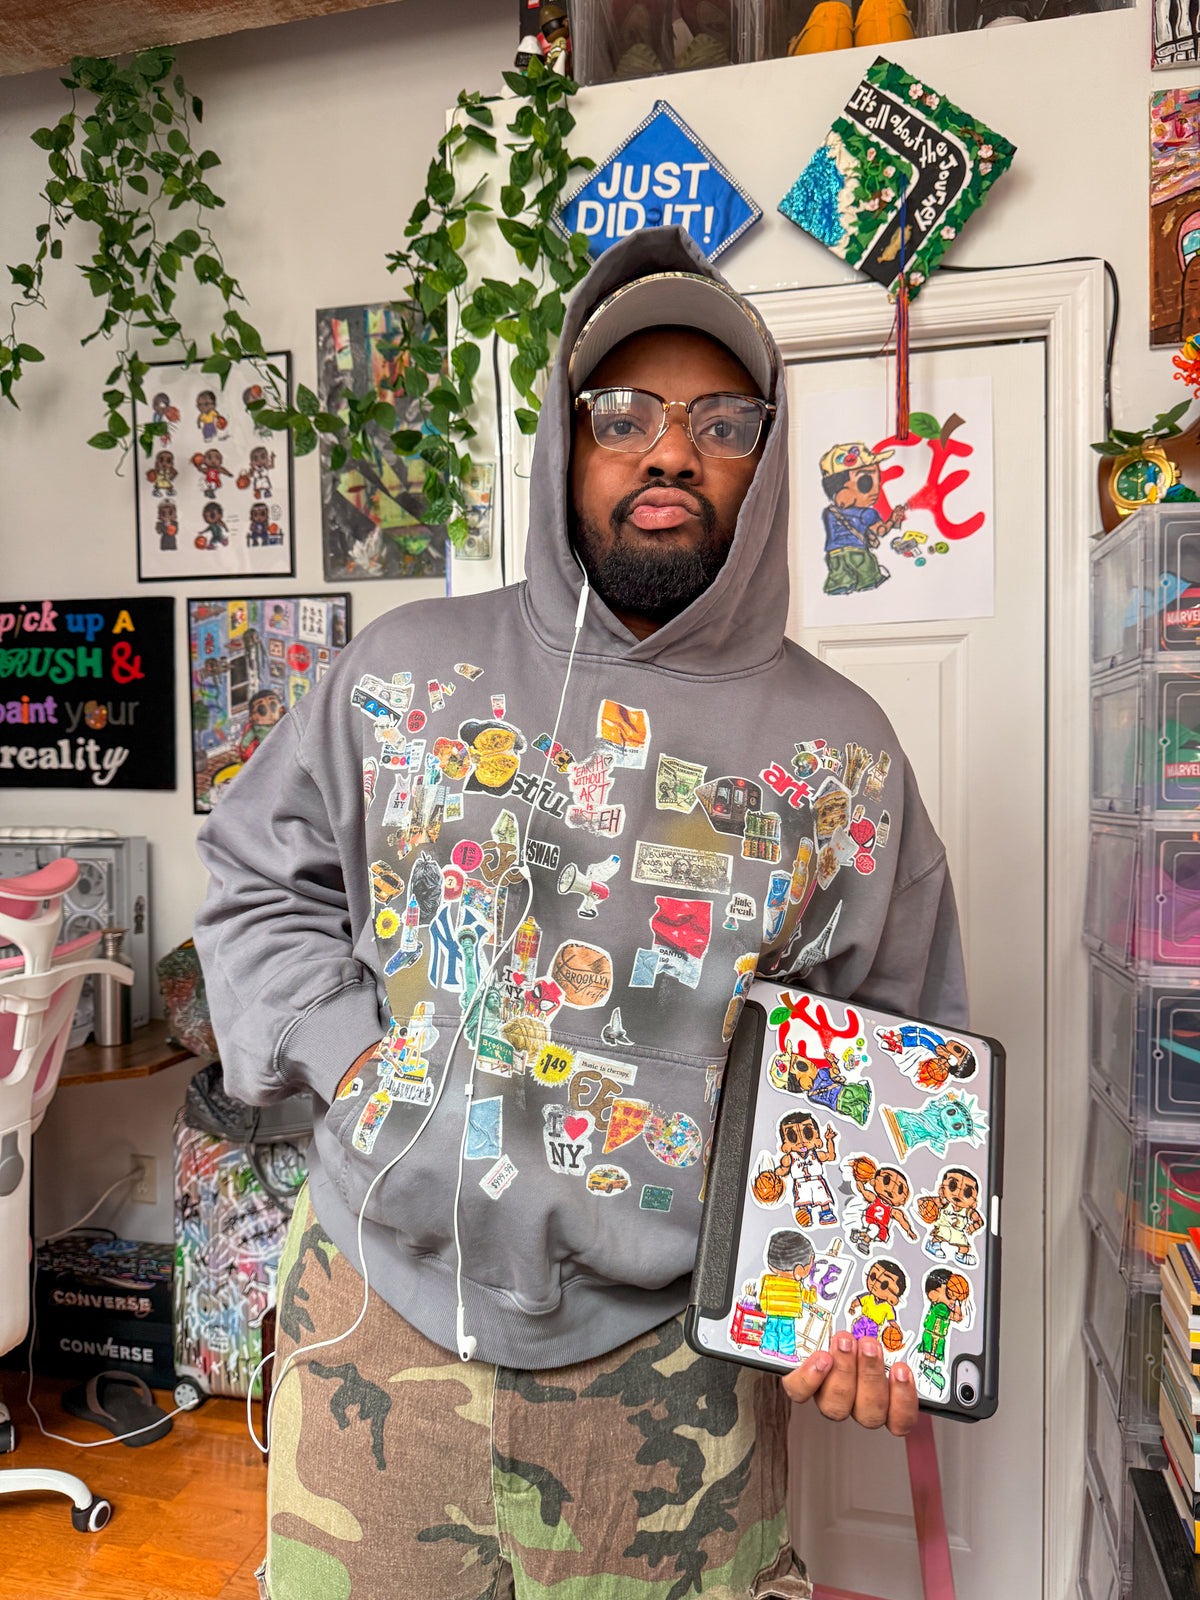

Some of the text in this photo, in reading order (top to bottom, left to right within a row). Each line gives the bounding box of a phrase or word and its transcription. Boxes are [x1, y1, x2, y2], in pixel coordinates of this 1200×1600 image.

[848, 85, 877, 113] It's
[865, 104, 891, 129] all
[890, 115, 926, 151] about
[919, 138, 947, 168] the
[598, 162, 710, 200] JUST
[576, 201, 714, 244] DID IT!
[0, 600, 135, 642] pick up A
[1166, 609, 1200, 624] MARVE
[112, 641, 145, 684] &
[0, 737, 130, 785] reality
[1166, 763, 1200, 778] MARVE
[573, 770, 608, 785] WITHOUT
[763, 764, 810, 807] art
[580, 782, 610, 804] ART
[598, 808, 621, 832] EH
[565, 970, 609, 988] BROOKLYN
[505, 985, 523, 999] NY
[581, 1061, 599, 1070] Music
[549, 1141, 584, 1168] NY
[874, 1206, 884, 1220] 2
[52, 1290, 151, 1314] CONVERSE
[59, 1337, 154, 1363] CONVERSE
